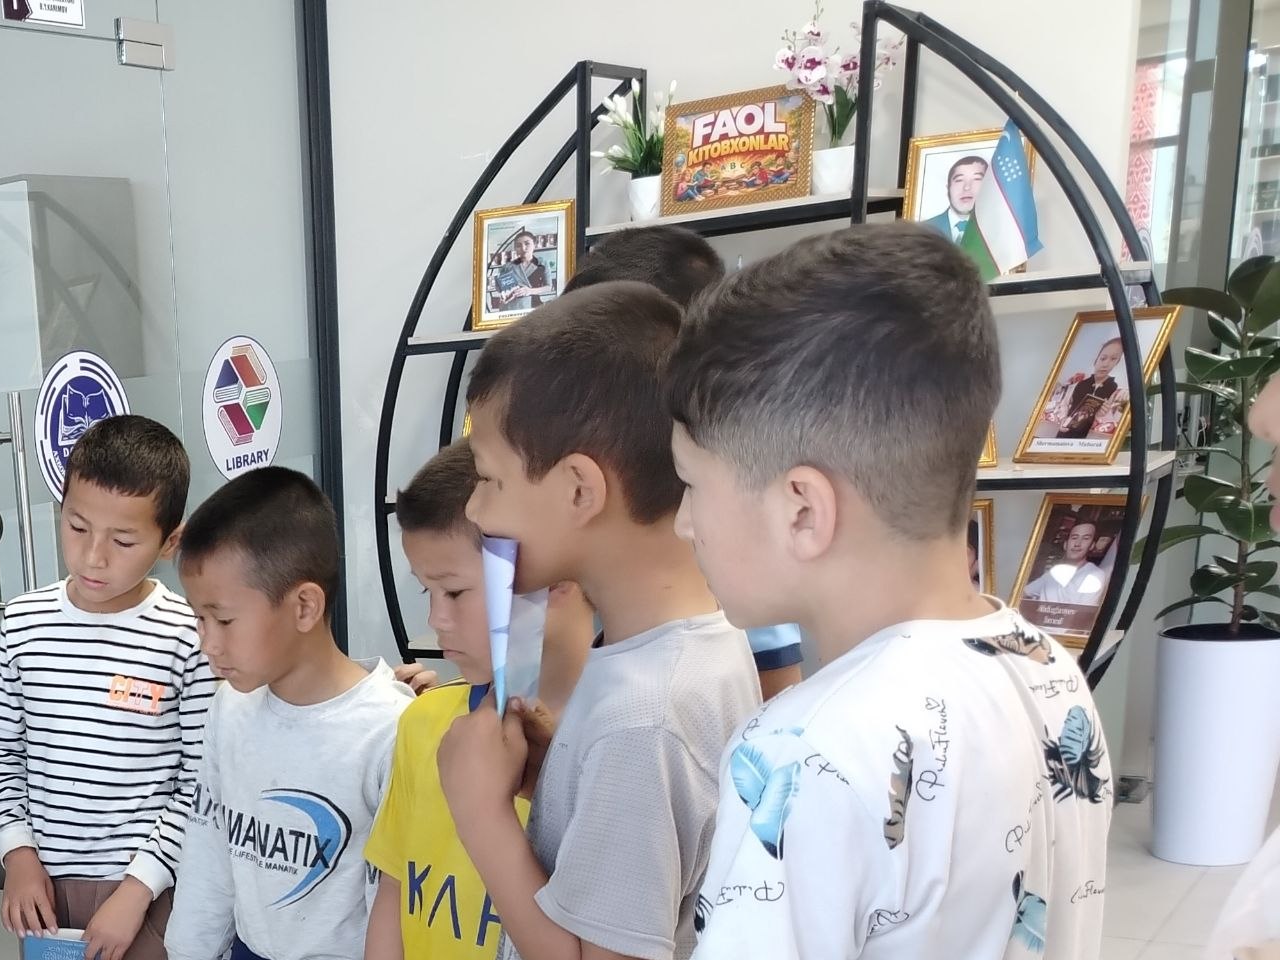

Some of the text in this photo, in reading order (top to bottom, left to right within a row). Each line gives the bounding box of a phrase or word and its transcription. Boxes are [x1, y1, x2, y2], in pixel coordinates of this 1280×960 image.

[691, 101, 787, 148] FAOL
[687, 134, 791, 167] KITOBXONLAR
[226, 448, 269, 471] LIBRARY
[109, 675, 166, 710] CITY
[223, 805, 332, 869] MANATIX
